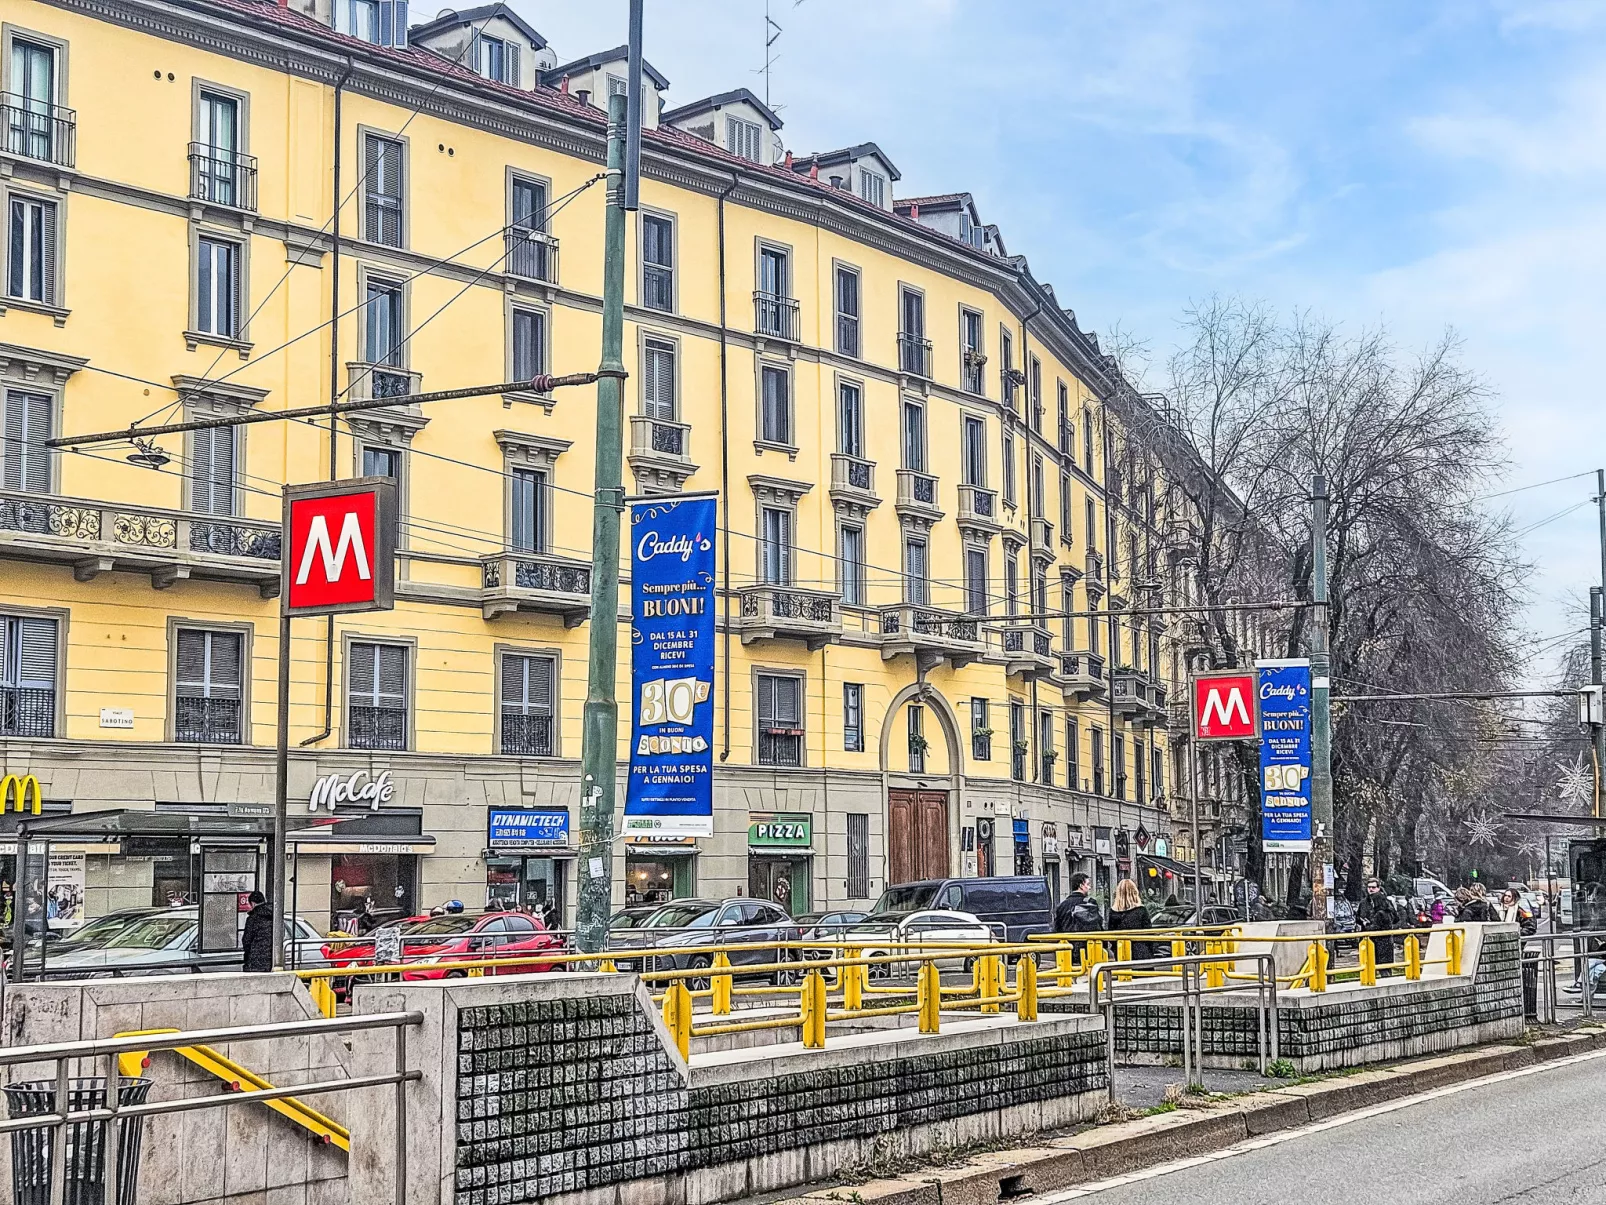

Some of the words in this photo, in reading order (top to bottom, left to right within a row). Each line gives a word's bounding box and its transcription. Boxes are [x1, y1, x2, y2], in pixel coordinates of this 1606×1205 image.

[295, 512, 371, 585] M
[637, 531, 711, 562] Caddy's
[642, 583, 680, 595] Sempre
[643, 598, 704, 617] BUONI!
[650, 632, 665, 640] DAL
[667, 631, 675, 639] 15
[676, 630, 686, 638] AL
[689, 630, 698, 638] 31
[653, 641, 694, 650] DICEMBRE
[660, 651, 685, 660] RICEVI
[1259, 682, 1306, 700] Caddy's
[1201, 688, 1250, 726] M
[1262, 711, 1288, 719] Sempre
[1263, 720, 1304, 731] BUONI!
[638, 737, 706, 754] SCONTO
[661, 765, 678, 773] TUA
[680, 765, 707, 773] SPESA
[652, 775, 695, 784] GENNAIO!
[308, 770, 394, 812] McCafé
[492, 815, 565, 827] DYNAMICTECH
[757, 824, 805, 838] PIZZA
[360, 844, 413, 853] McDonald's
